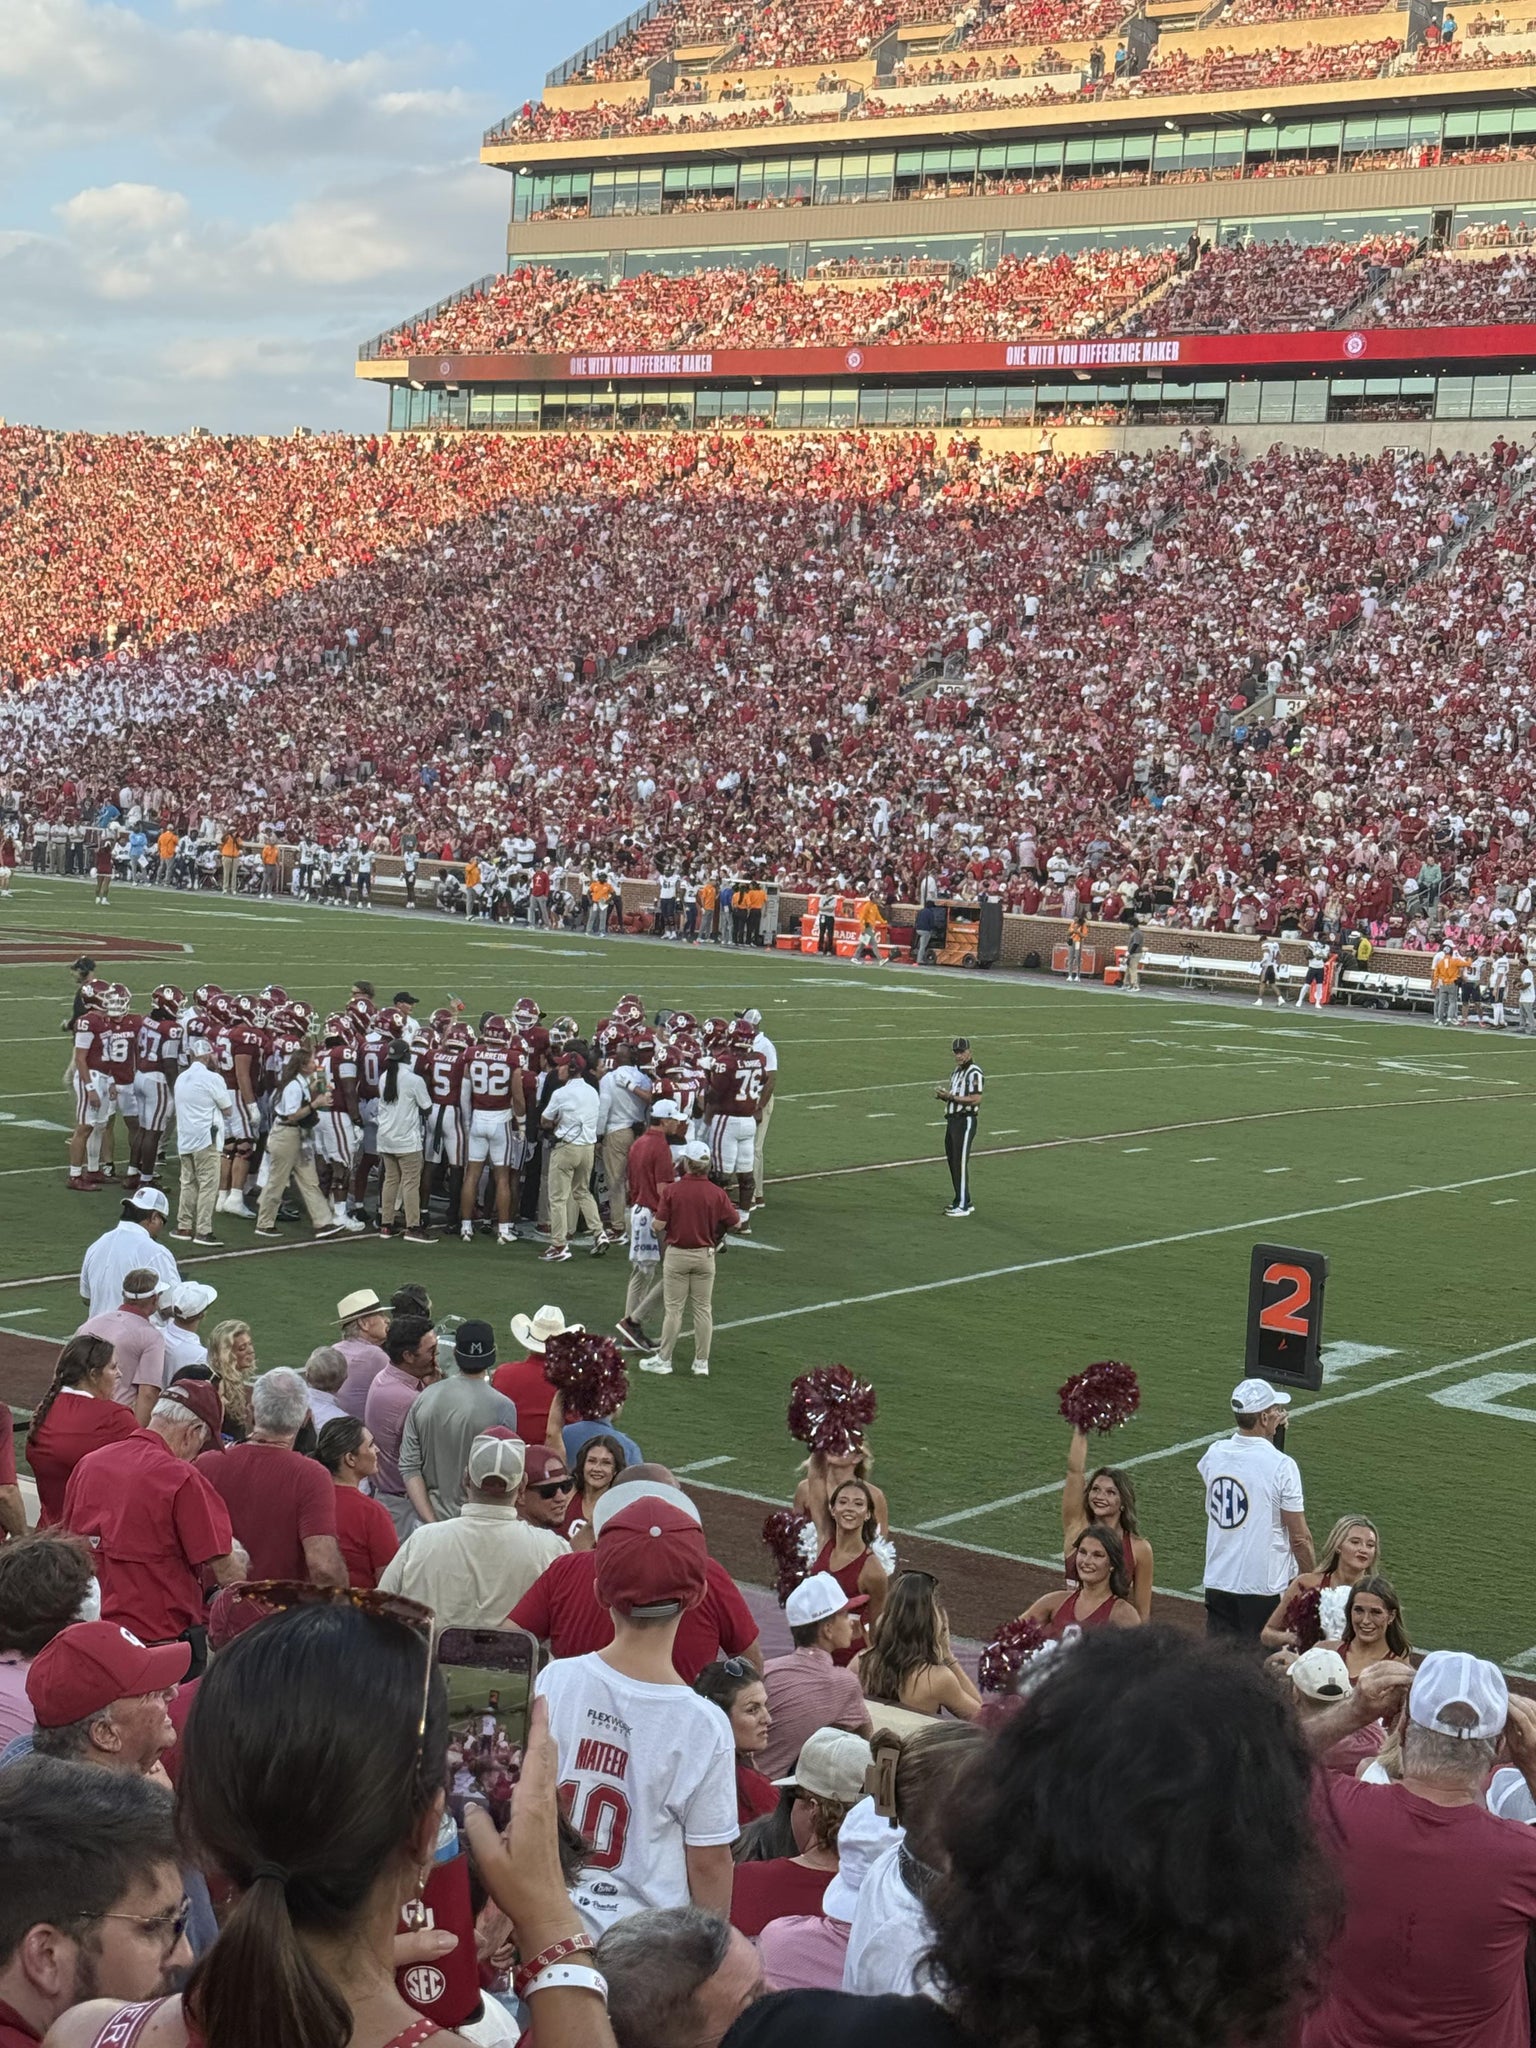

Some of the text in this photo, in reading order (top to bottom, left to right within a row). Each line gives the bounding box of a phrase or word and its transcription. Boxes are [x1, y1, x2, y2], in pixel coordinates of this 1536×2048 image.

[570, 354, 712, 376] ONE WITH YOU DIFFERENCE MAKER
[1006, 341, 1180, 366] ONE WITH YOU DIFFERENCE MAKER
[811, 928, 857, 940] GRADE
[169, 1027, 183, 1038] 87
[242, 1032, 257, 1043] 73
[343, 1048, 357, 1061] 64
[364, 1053, 379, 1086] 0
[433, 1062, 452, 1096] 5
[470, 1060, 511, 1096] 82
[735, 1068, 764, 1101] 76
[1260, 1262, 1311, 1337] 2
[470, 1342, 483, 1354] M
[1210, 1478, 1247, 1527] SEC
[574, 1738, 629, 1781] MATEER
[407, 1969, 442, 2001] SEC
